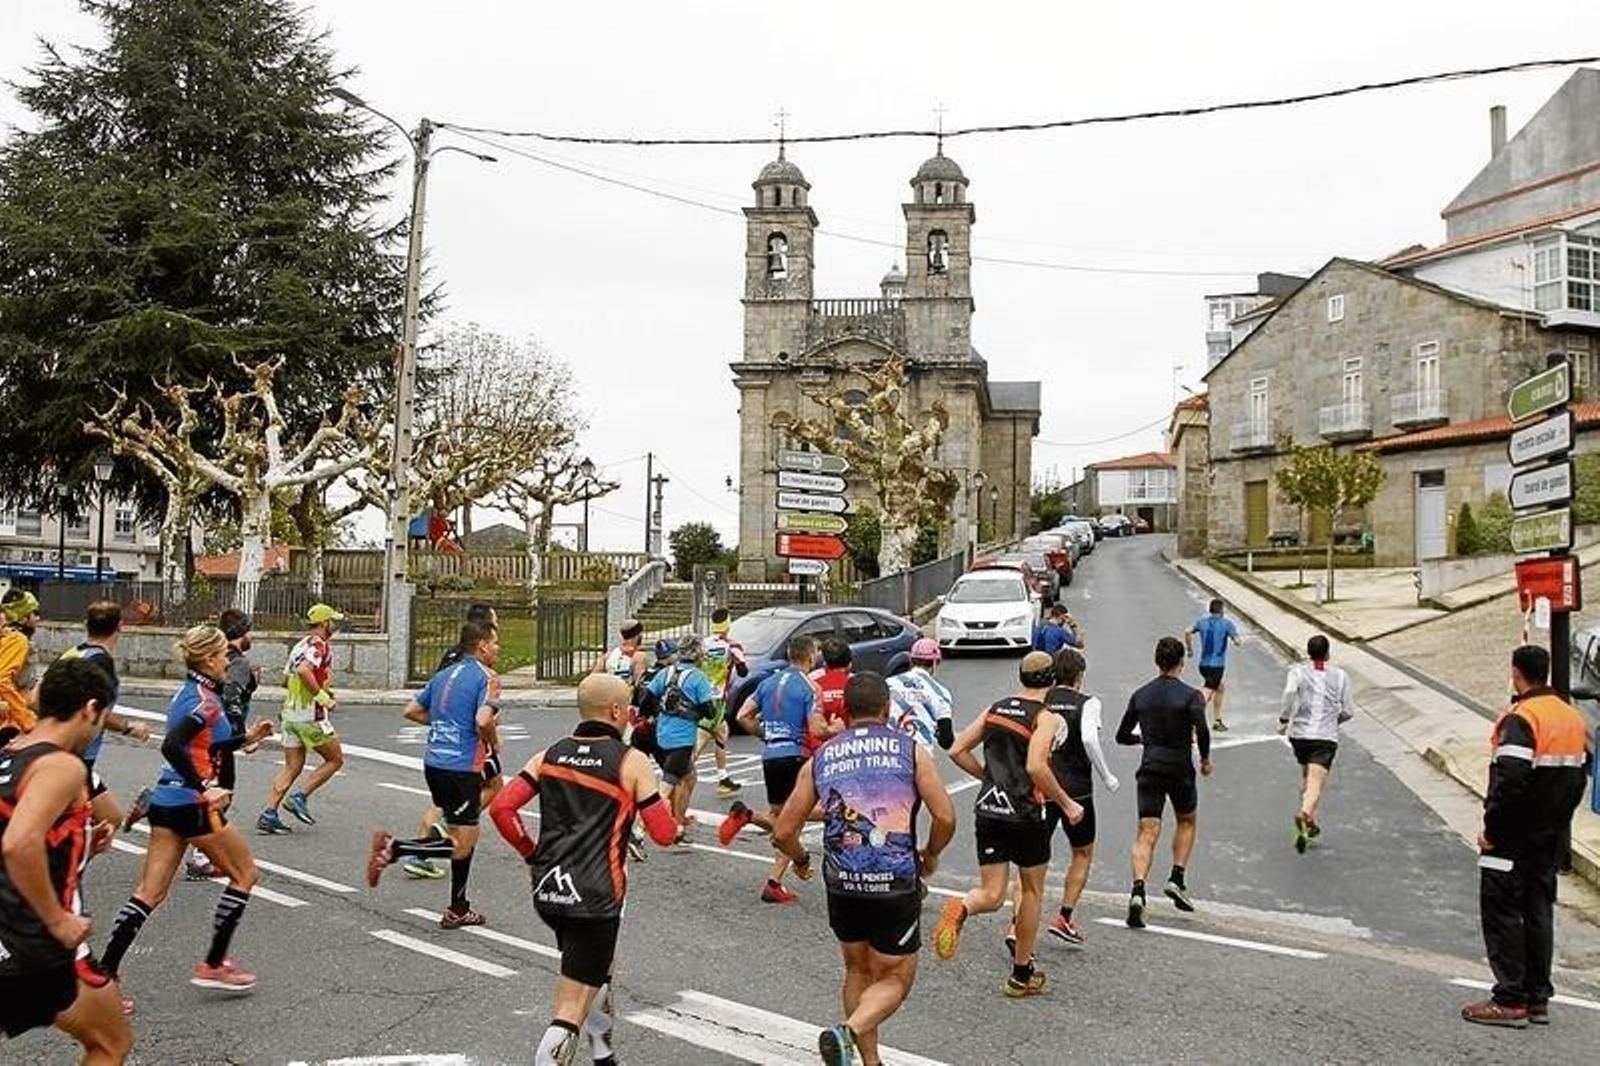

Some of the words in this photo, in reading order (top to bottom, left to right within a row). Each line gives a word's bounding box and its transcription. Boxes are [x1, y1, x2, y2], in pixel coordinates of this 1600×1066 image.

[823, 737, 900, 761] RUNNING
[823, 757, 861, 777] SPORT
[866, 755, 902, 769] TRAIL
